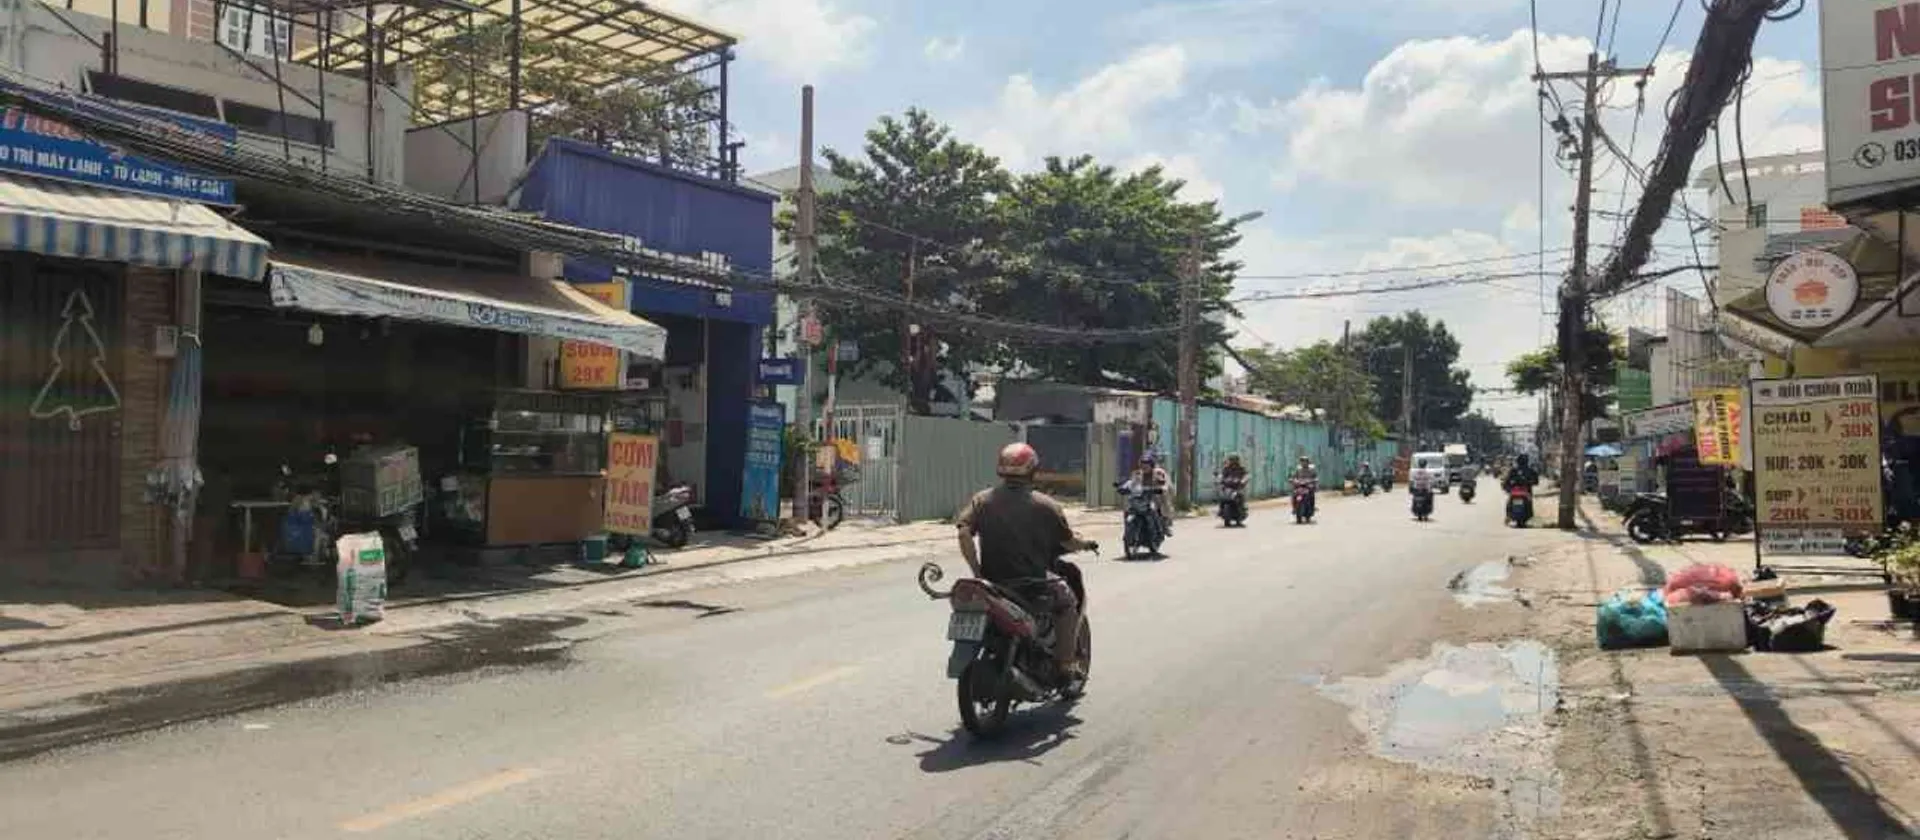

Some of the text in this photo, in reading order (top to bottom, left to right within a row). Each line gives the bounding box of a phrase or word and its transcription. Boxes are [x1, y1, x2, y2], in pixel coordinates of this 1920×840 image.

[1838, 402, 1873, 418] 20K
[1840, 423, 1873, 438] 30K
[1798, 455, 1826, 471] 20K
[1839, 454, 1868, 470] 30K
[1770, 507, 1810, 521] 20K
[1833, 507, 1874, 521] 30K
